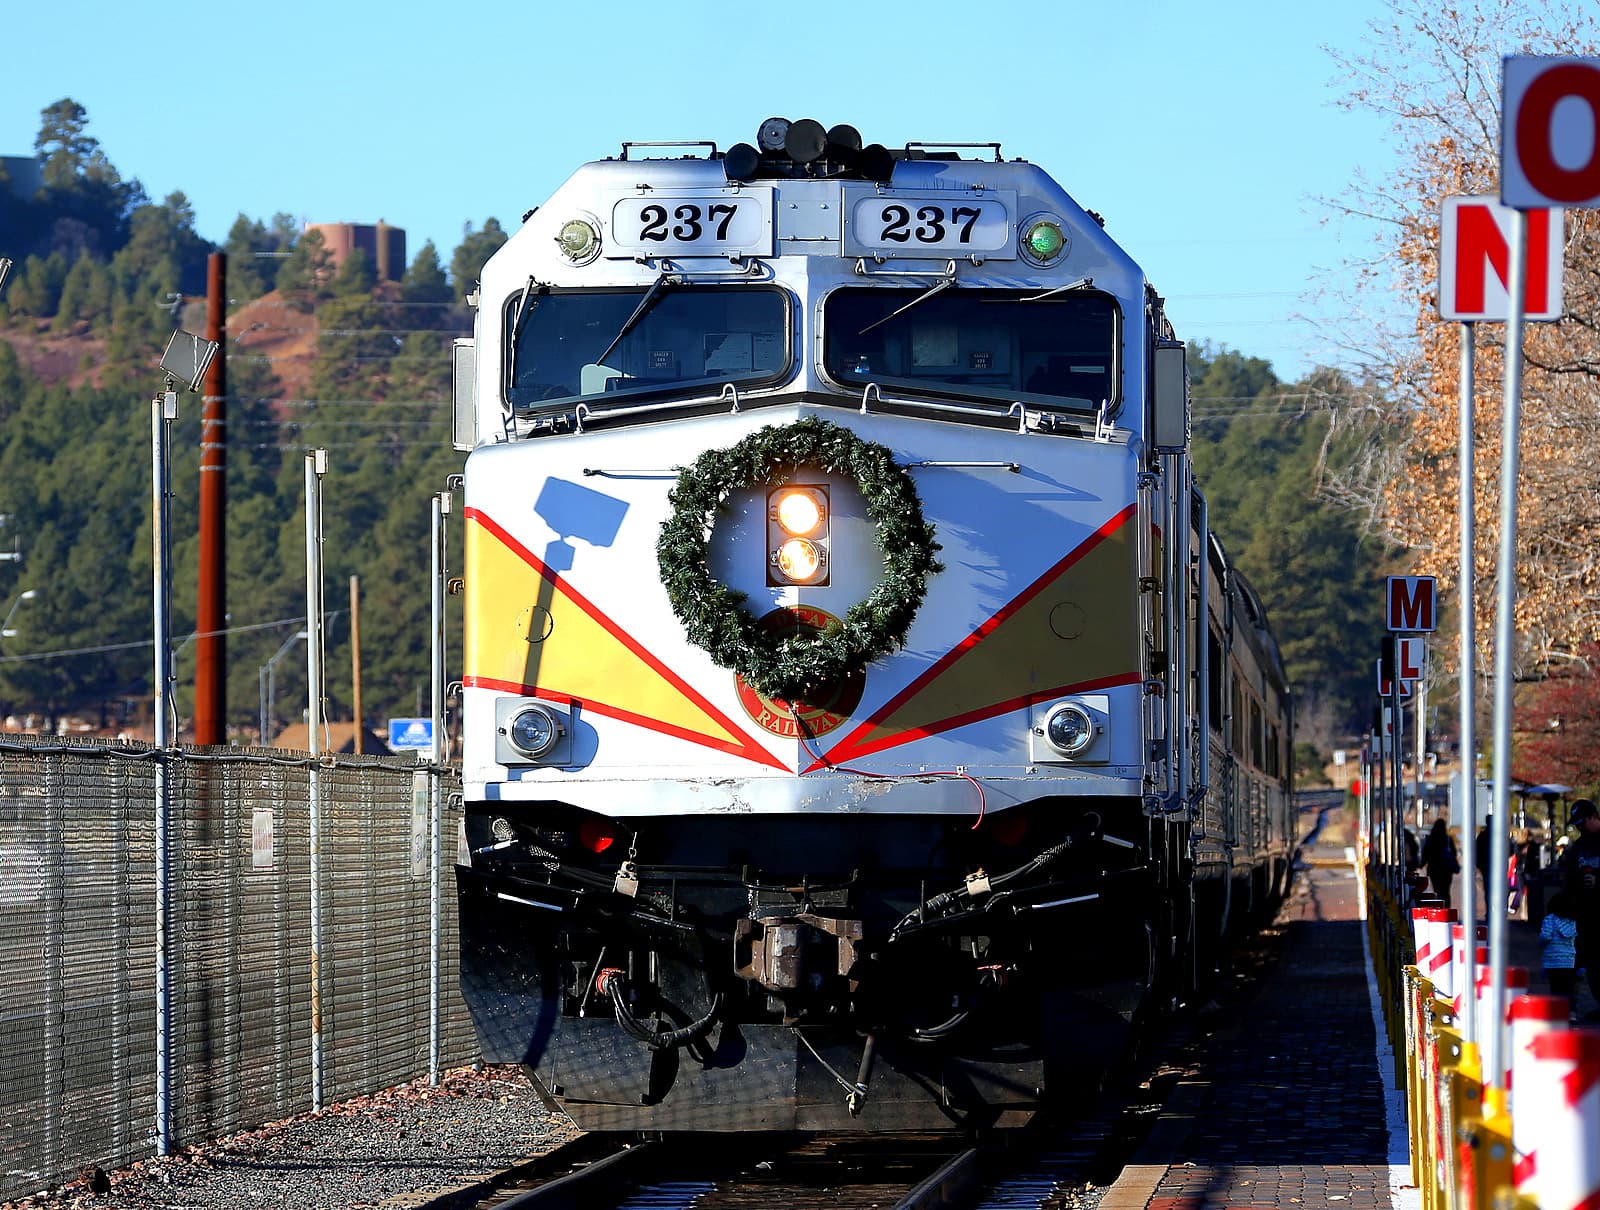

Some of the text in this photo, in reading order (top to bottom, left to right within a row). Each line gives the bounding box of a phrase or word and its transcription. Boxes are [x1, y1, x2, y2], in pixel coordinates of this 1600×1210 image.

[640, 204, 738, 241] 237
[880, 204, 982, 243] 237
[1455, 203, 1550, 314] N
[1391, 578, 1433, 629] M
[1401, 640, 1419, 678] L
